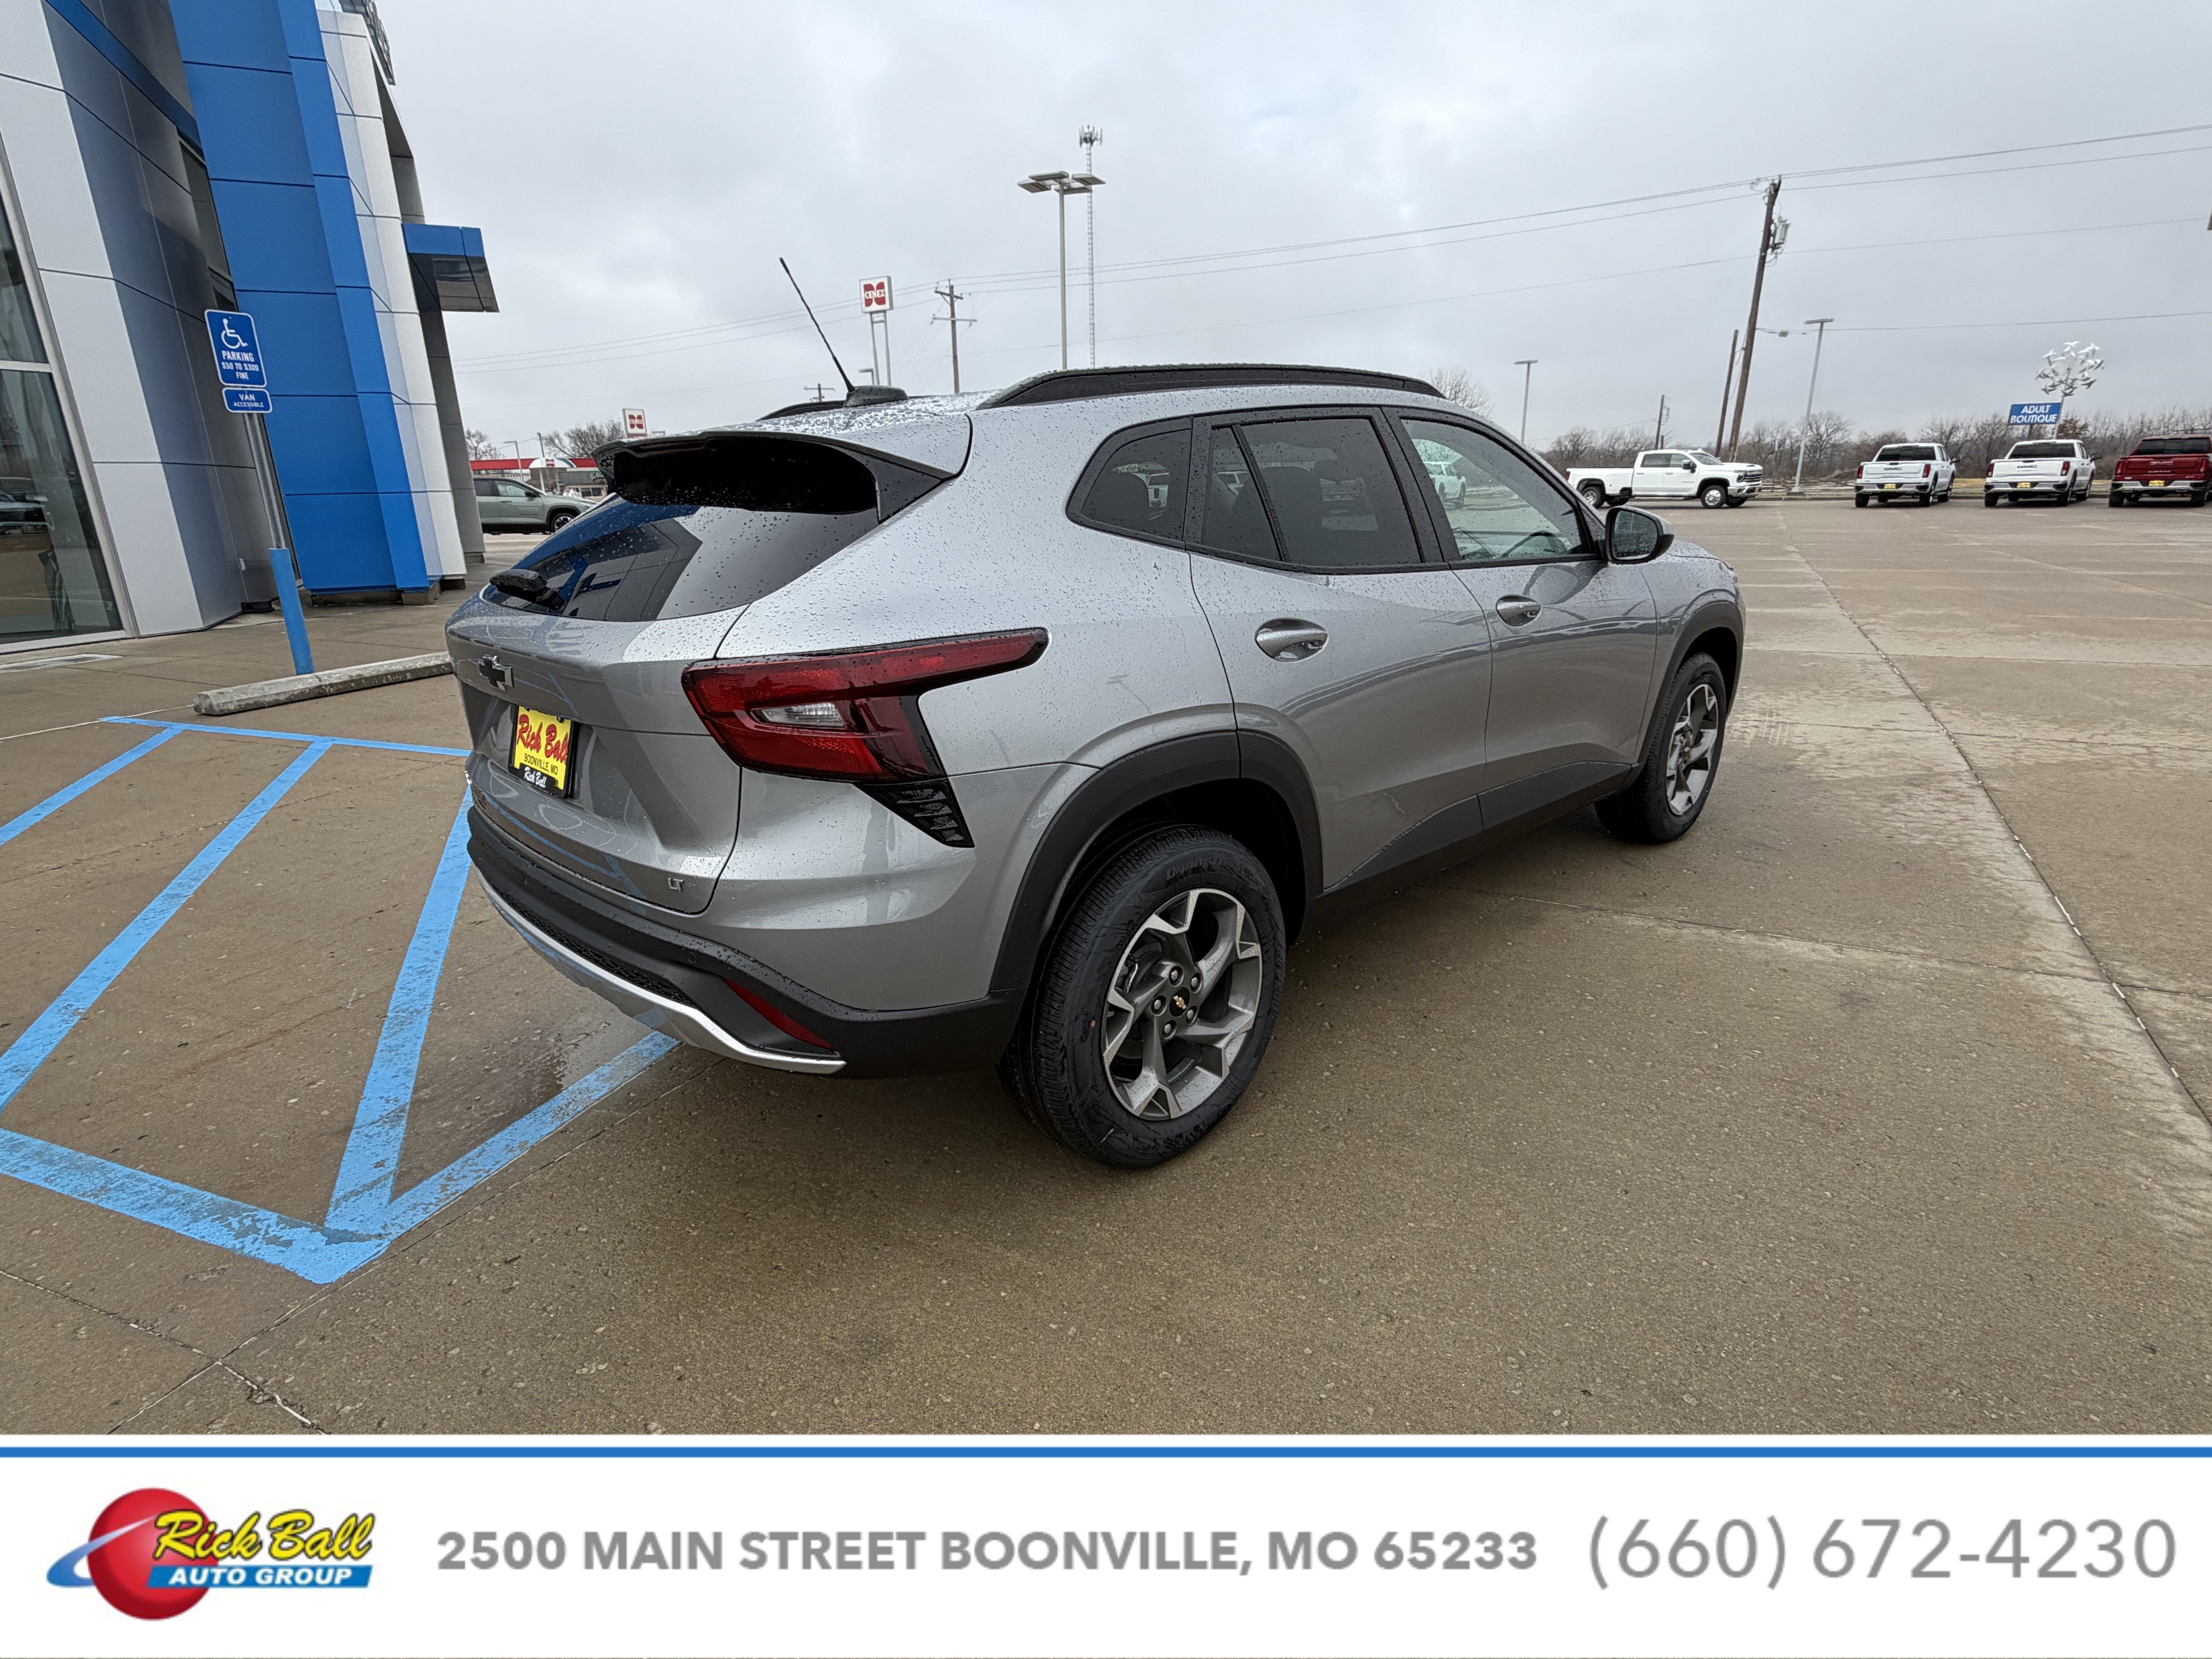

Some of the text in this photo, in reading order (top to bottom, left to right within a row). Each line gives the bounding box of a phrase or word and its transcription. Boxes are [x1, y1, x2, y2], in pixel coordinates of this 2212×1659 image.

[222, 350, 254, 362] PARKING
[221, 362, 259, 371] $50 TO $300
[235, 372, 249, 380] FINE
[2021, 405, 2052, 414] ADULT
[2010, 414, 2057, 423] BOUTIQUE
[517, 714, 568, 764] Rick Ball
[551, 763, 558, 775] MO
[668, 878, 683, 891] LT
